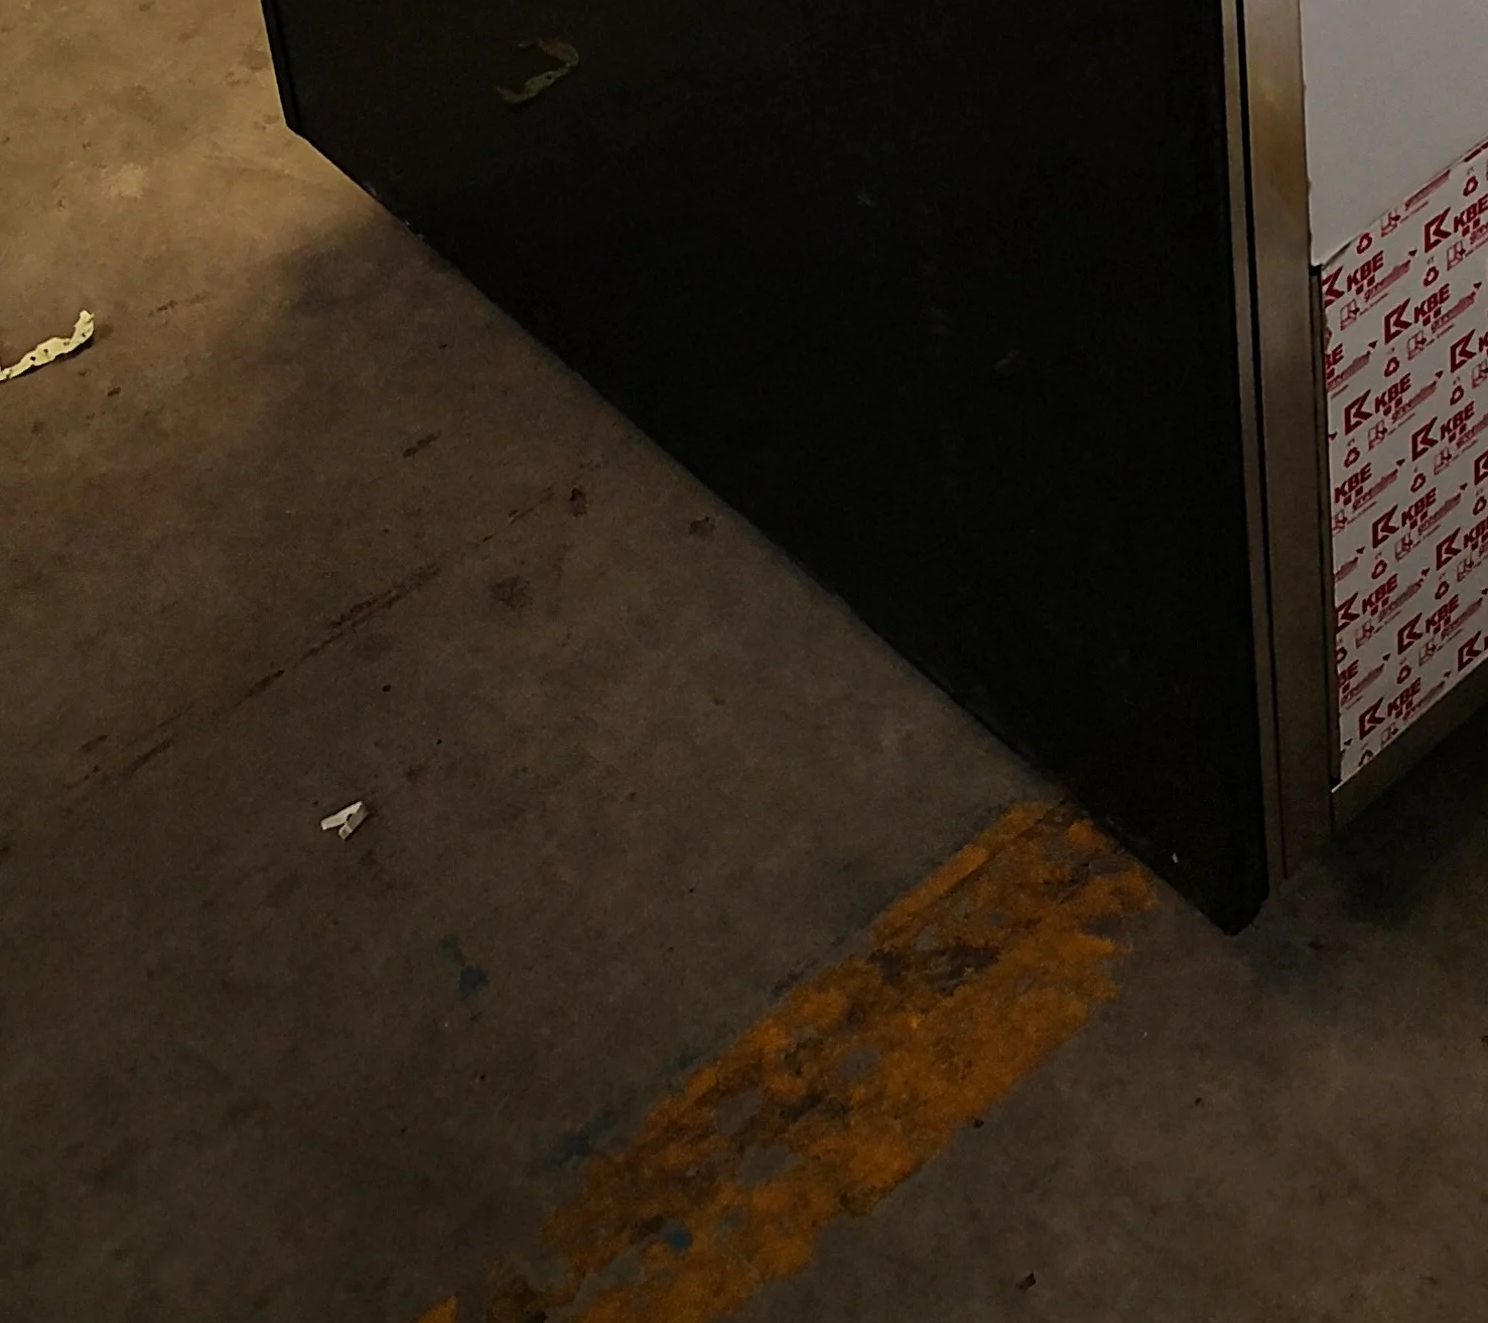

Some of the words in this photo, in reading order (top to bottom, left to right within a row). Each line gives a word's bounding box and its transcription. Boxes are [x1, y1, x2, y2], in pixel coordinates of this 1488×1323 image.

[1453, 194, 1488, 234] KBE
[1346, 252, 1384, 292] KBE
[1414, 283, 1450, 323] KBE
[1374, 373, 1412, 413] KBE
[1440, 402, 1474, 440] KBE
[1334, 464, 1372, 502] KBE
[1402, 490, 1435, 526] KBE
[1362, 576, 1396, 612] KBE
[1426, 597, 1457, 631] KBE
[1388, 681, 1419, 715] KBE
